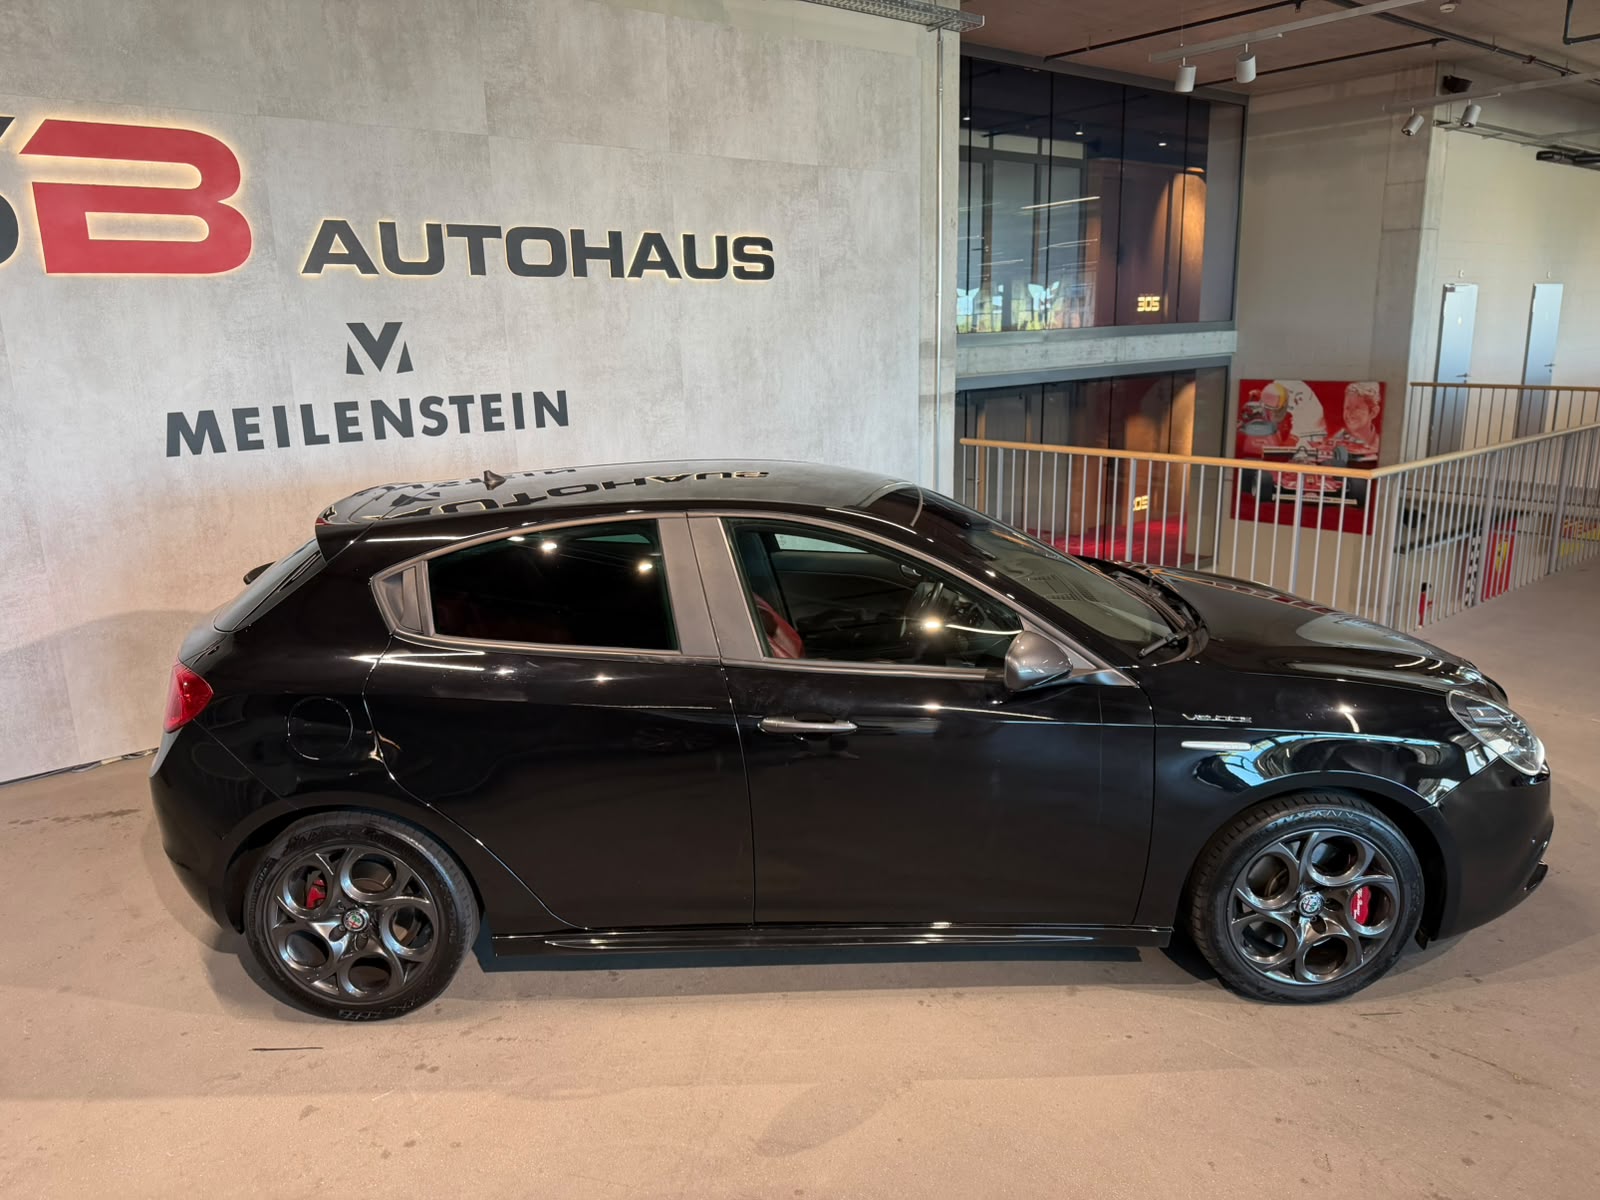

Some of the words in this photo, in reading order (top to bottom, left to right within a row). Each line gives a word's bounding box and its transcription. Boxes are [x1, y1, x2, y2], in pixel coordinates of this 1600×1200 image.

[302, 219, 775, 280] AUTOHAUS
[1136, 295, 1161, 312] 305
[166, 390, 569, 457] MEILENSTEIN
